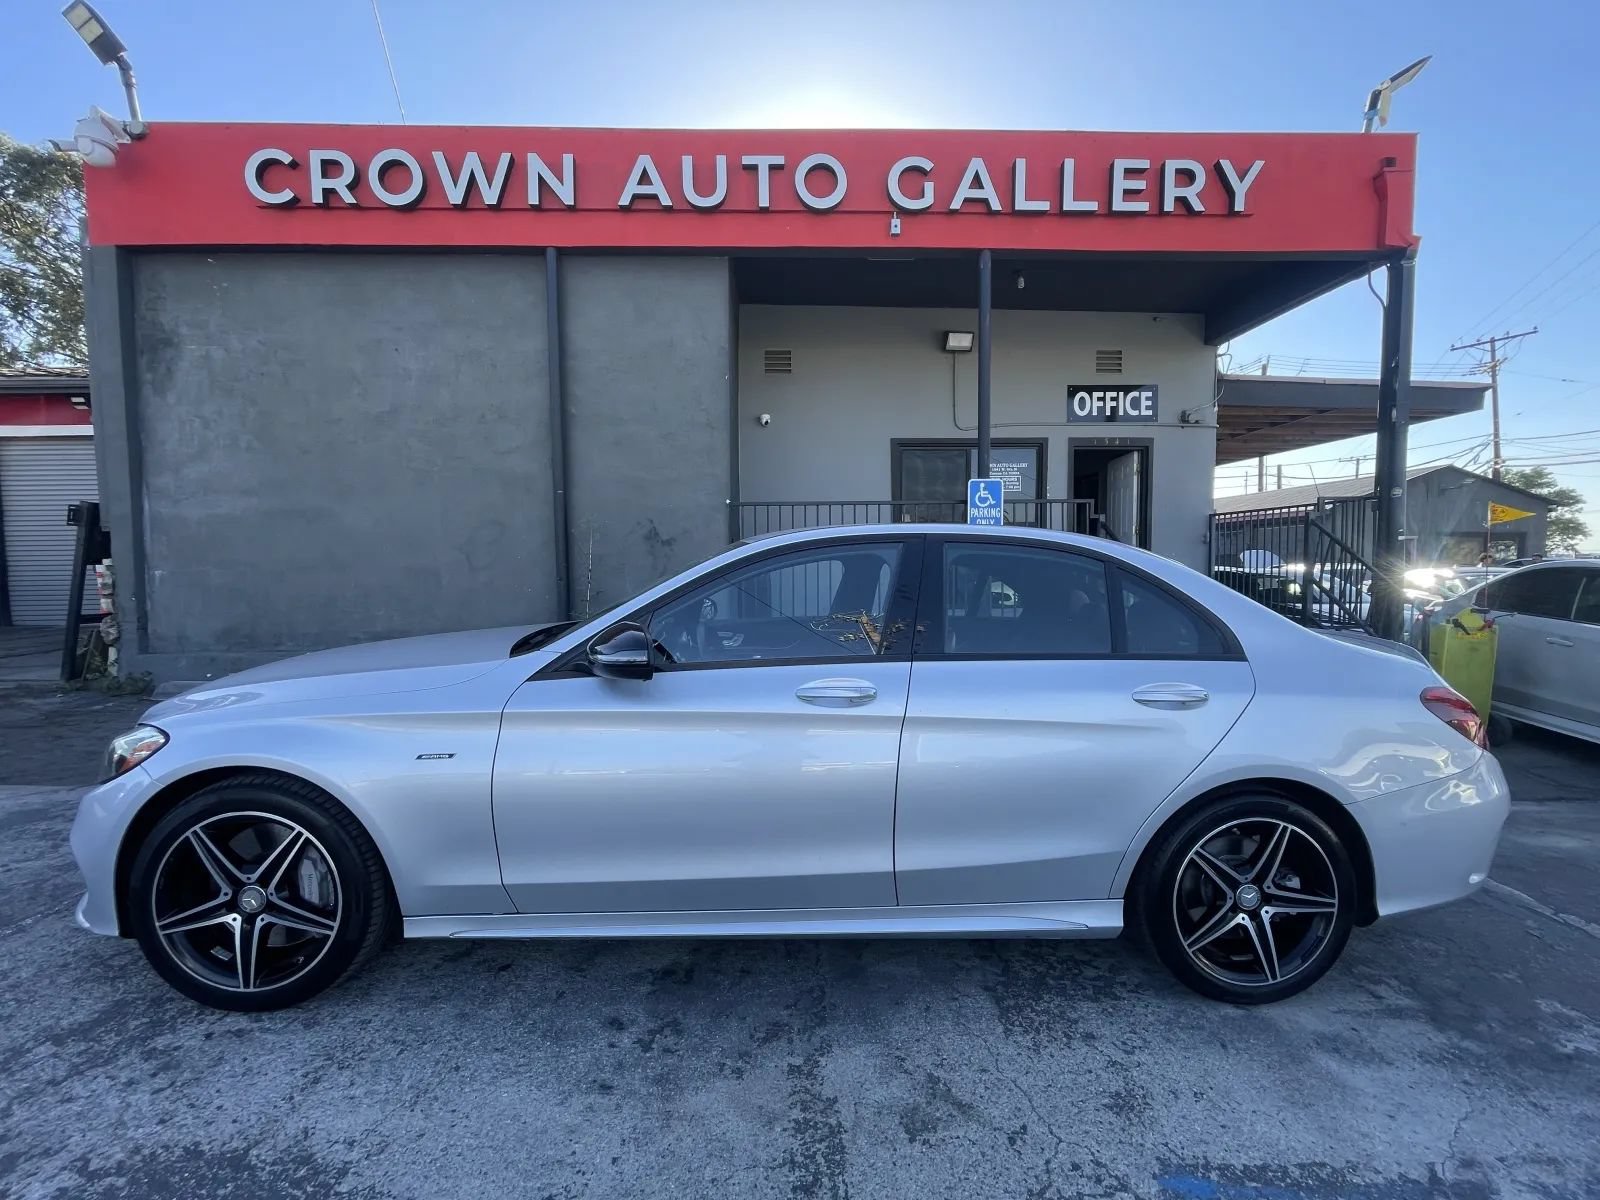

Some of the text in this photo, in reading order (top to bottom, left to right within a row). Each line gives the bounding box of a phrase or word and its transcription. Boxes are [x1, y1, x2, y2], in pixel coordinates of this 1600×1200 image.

[244, 148, 1265, 212] CROWN AUTO GALLERY
[1073, 391, 1153, 417] OFFICE
[970, 507, 1001, 518] PARKING
